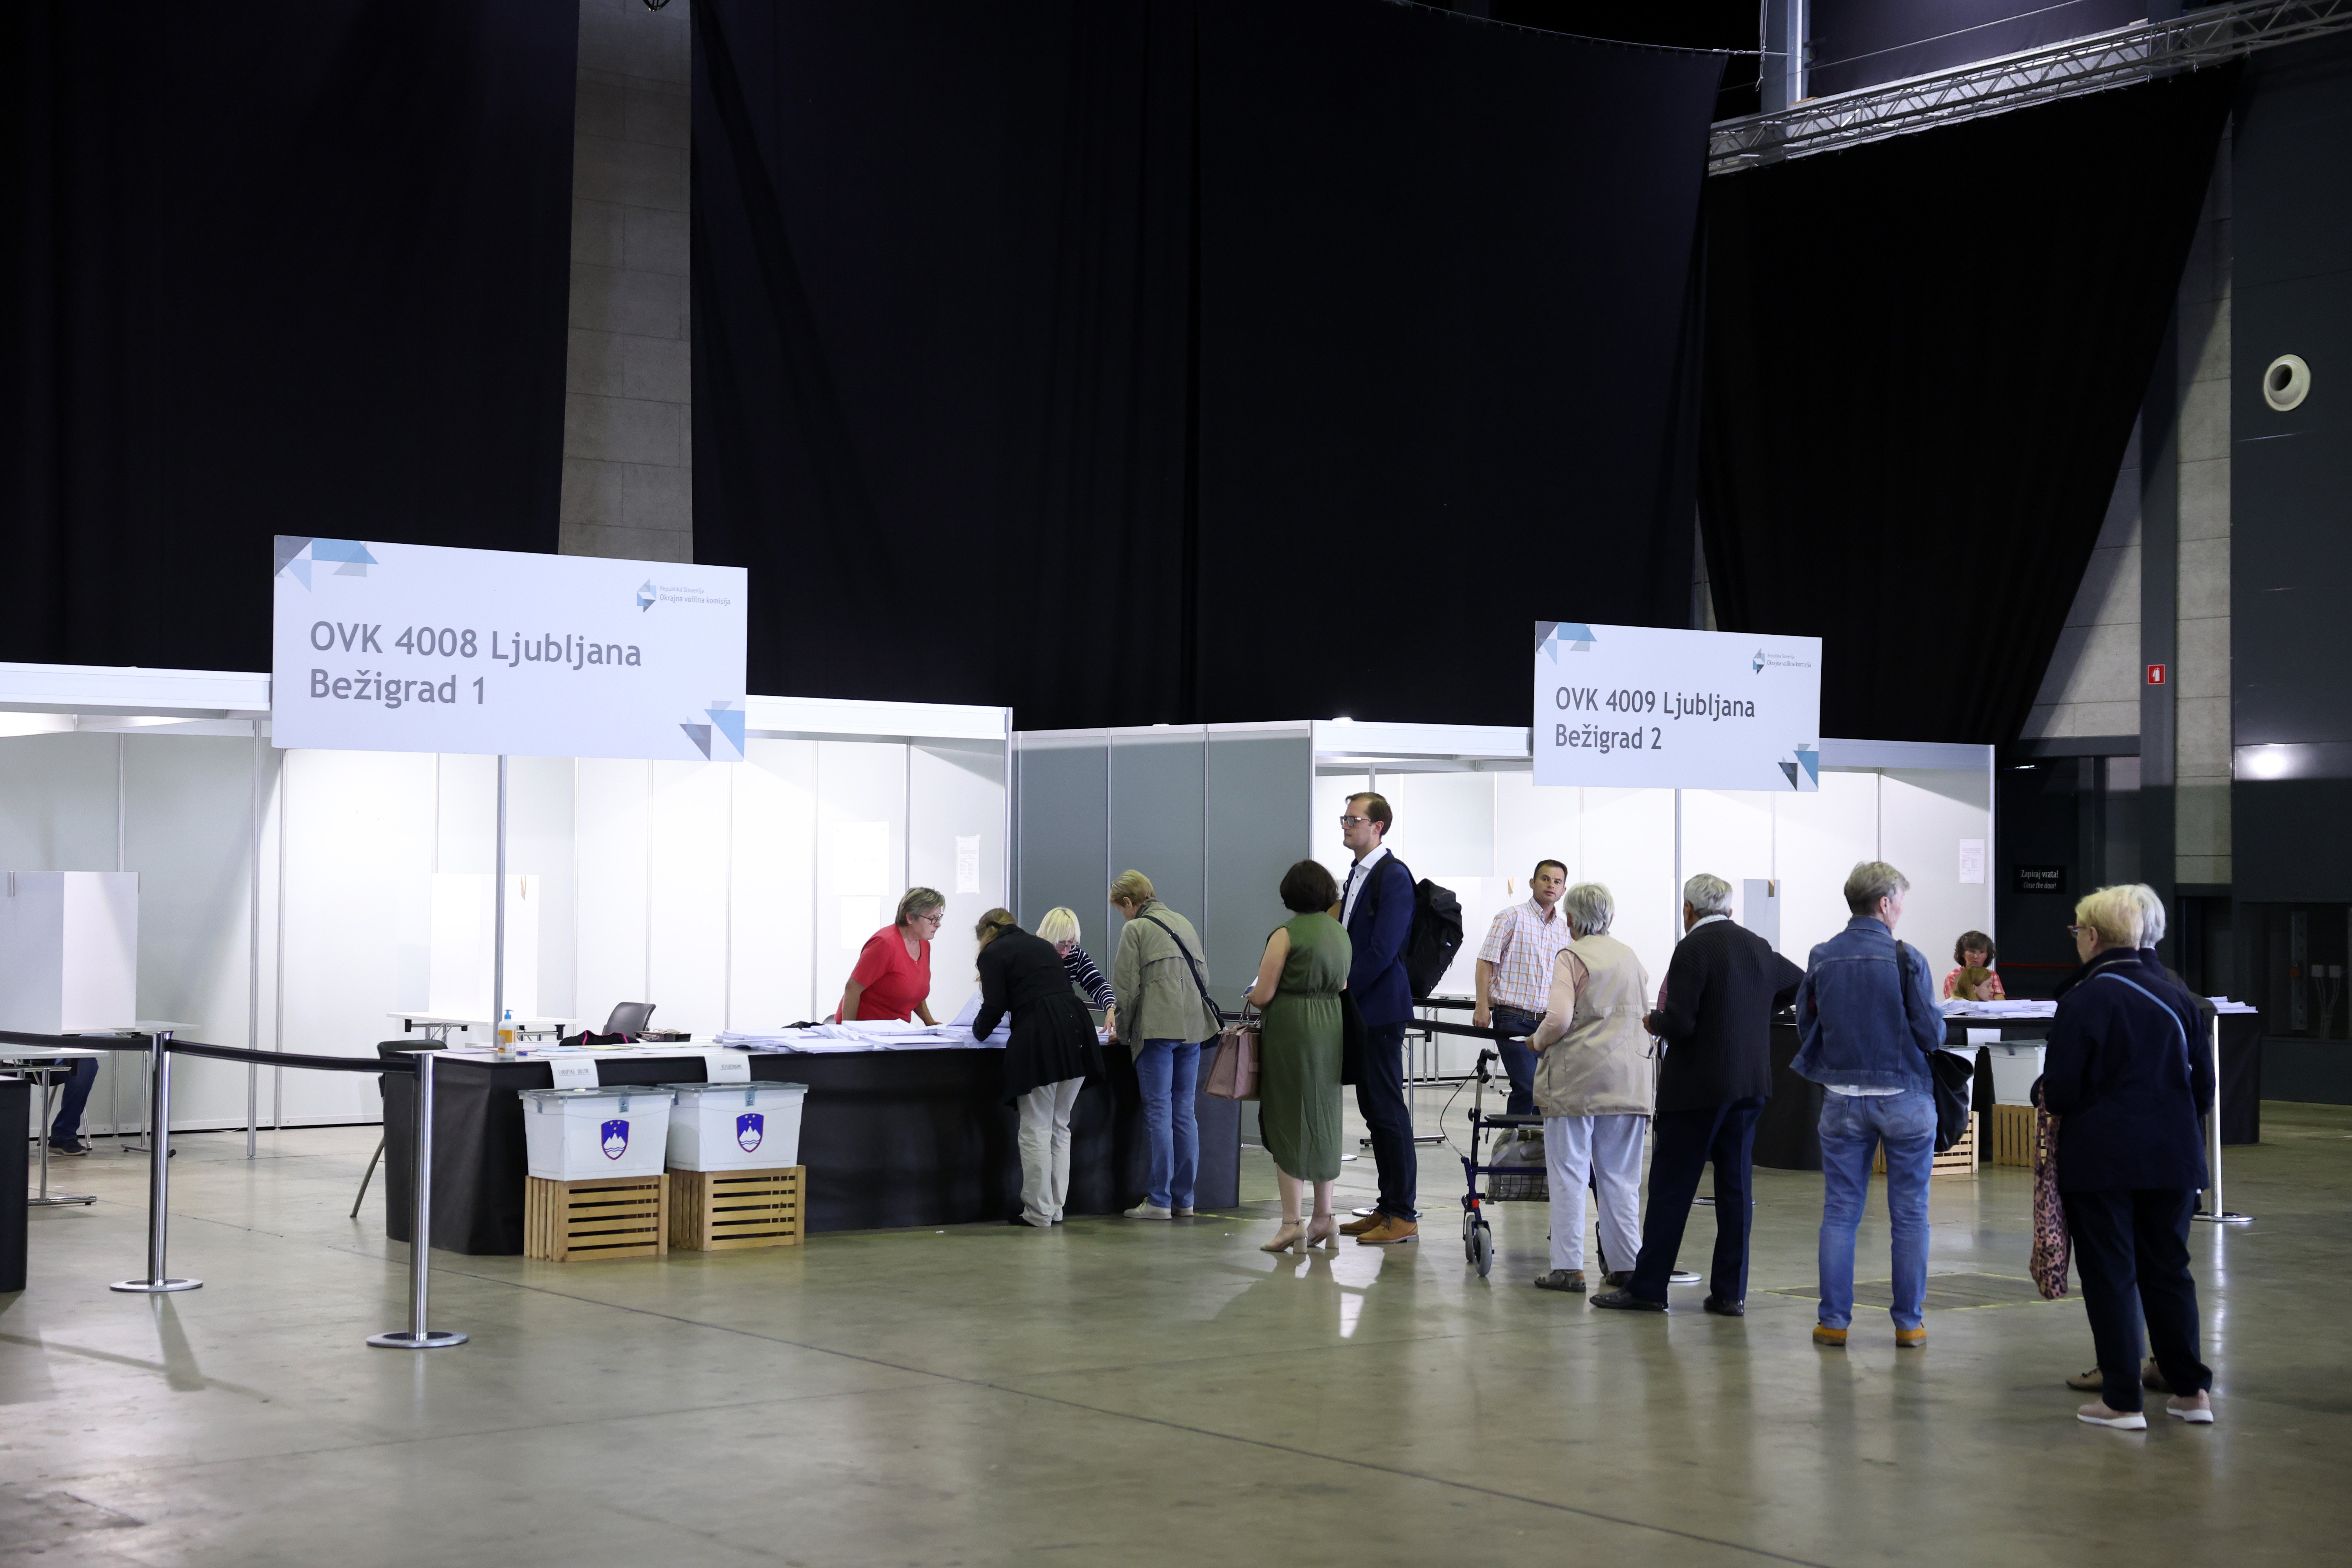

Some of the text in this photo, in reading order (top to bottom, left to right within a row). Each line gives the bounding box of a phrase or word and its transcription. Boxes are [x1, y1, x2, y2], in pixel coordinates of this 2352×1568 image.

[660, 594, 683, 603] Okrajna
[706, 597, 731, 606] komisija
[311, 621, 641, 670] OVK 4008 Ljubljana
[311, 669, 485, 708] Bežigrad 1
[1556, 687, 1755, 722] OVK 4009 Ljubljana
[1556, 724, 1662, 754] Bežigrad 2
[2021, 869, 2041, 879] Zapiraj
